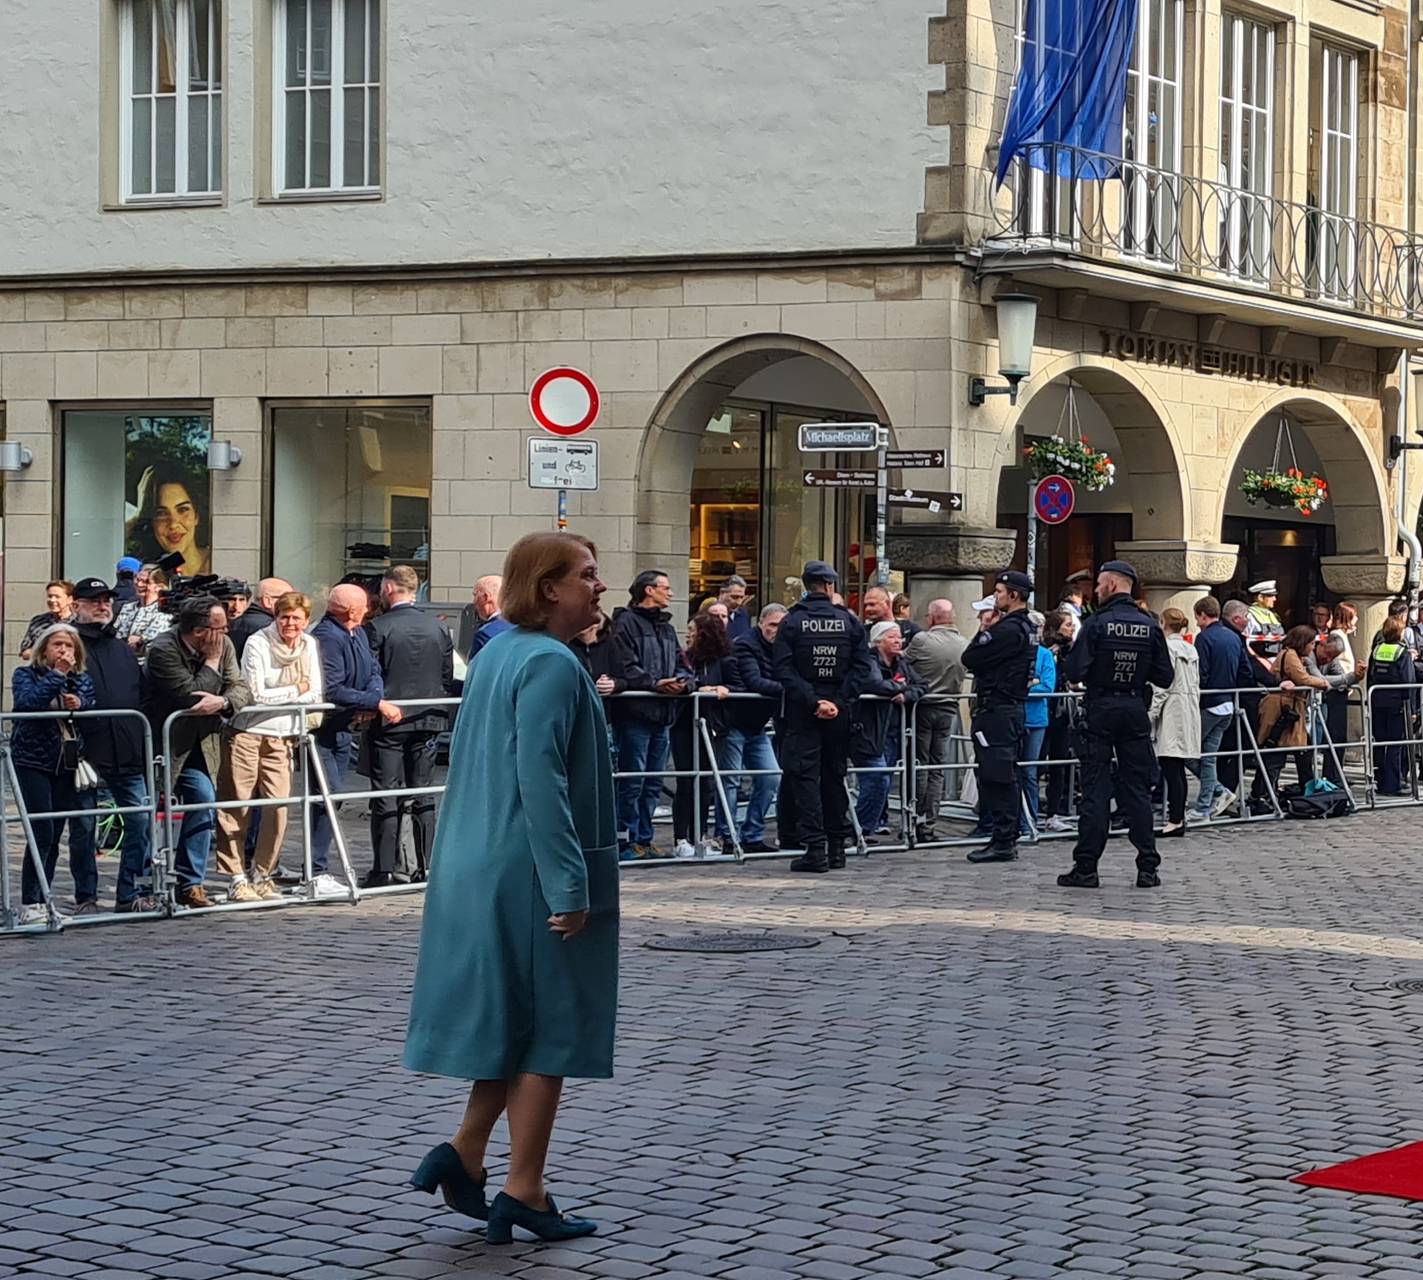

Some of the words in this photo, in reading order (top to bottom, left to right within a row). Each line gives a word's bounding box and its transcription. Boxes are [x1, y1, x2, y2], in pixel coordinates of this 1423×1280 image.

[1099, 330, 1196, 371] TOMMY
[805, 430, 871, 444] Michaelisplatz
[801, 620, 846, 632] POLIZEI
[1107, 622, 1150, 638] POLIZEI
[812, 645, 837, 655] NRW
[813, 656, 837, 667] 2723
[1113, 651, 1138, 662] NRW
[1114, 661, 1137, 672] 2721
[818, 668, 833, 677] RH
[1113, 672, 1135, 683] FLT
